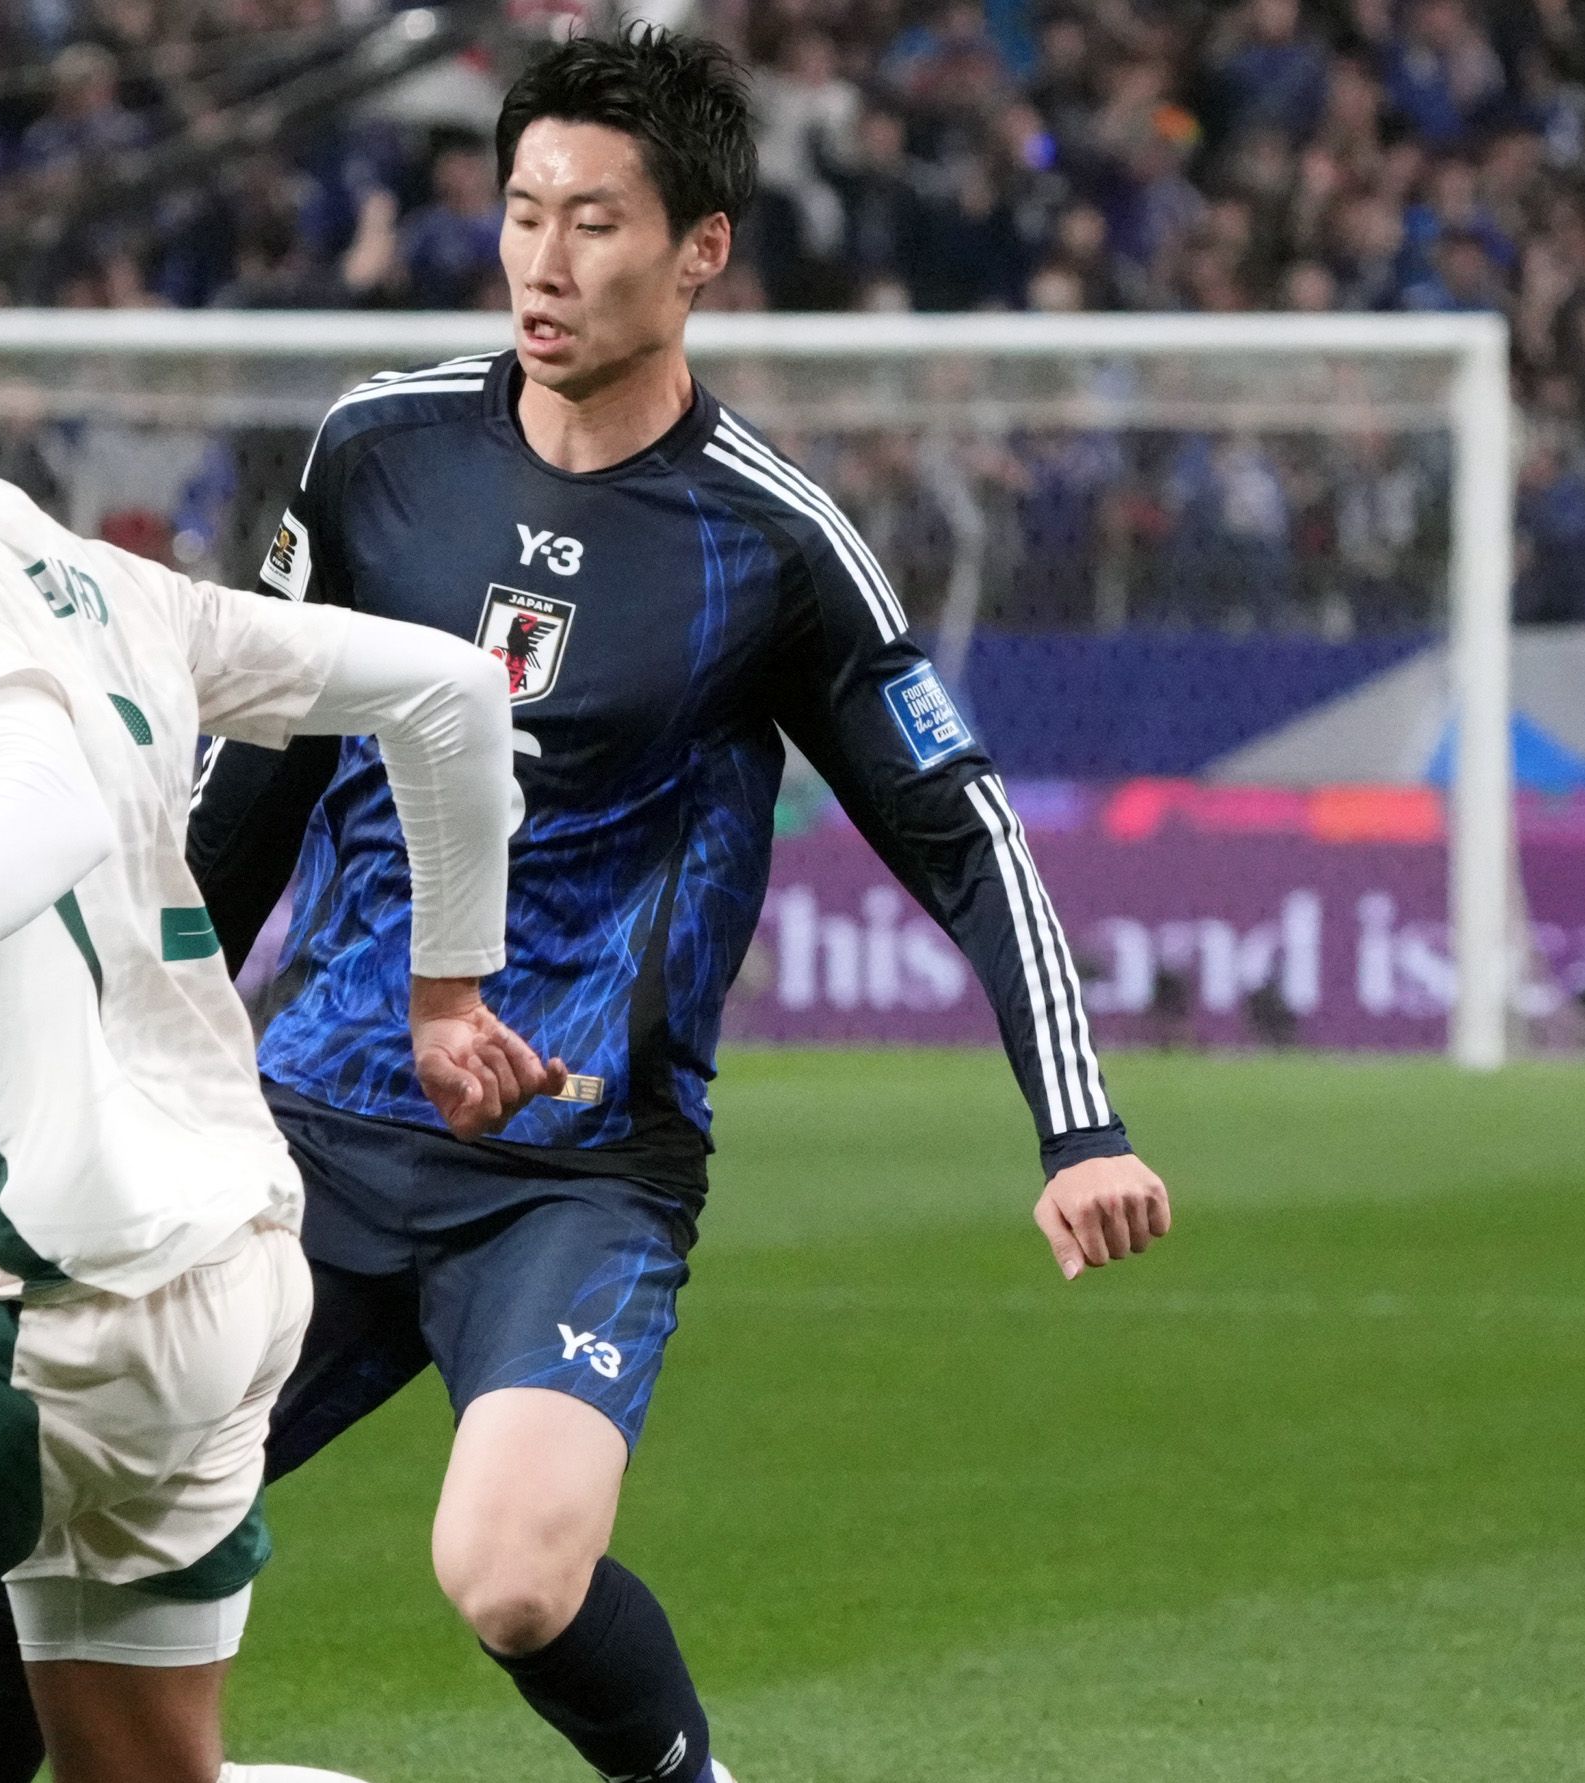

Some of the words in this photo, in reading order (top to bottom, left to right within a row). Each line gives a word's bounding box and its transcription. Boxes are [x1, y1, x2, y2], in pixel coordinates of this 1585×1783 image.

[516, 523, 584, 576] Y-3
[508, 594, 554, 613] JAPAN
[907, 688, 947, 719] UNITES
[913, 716, 934, 734] the
[762, 883, 966, 1012] his
[1076, 887, 1322, 1015] and
[556, 1323, 622, 1379] Y-3
